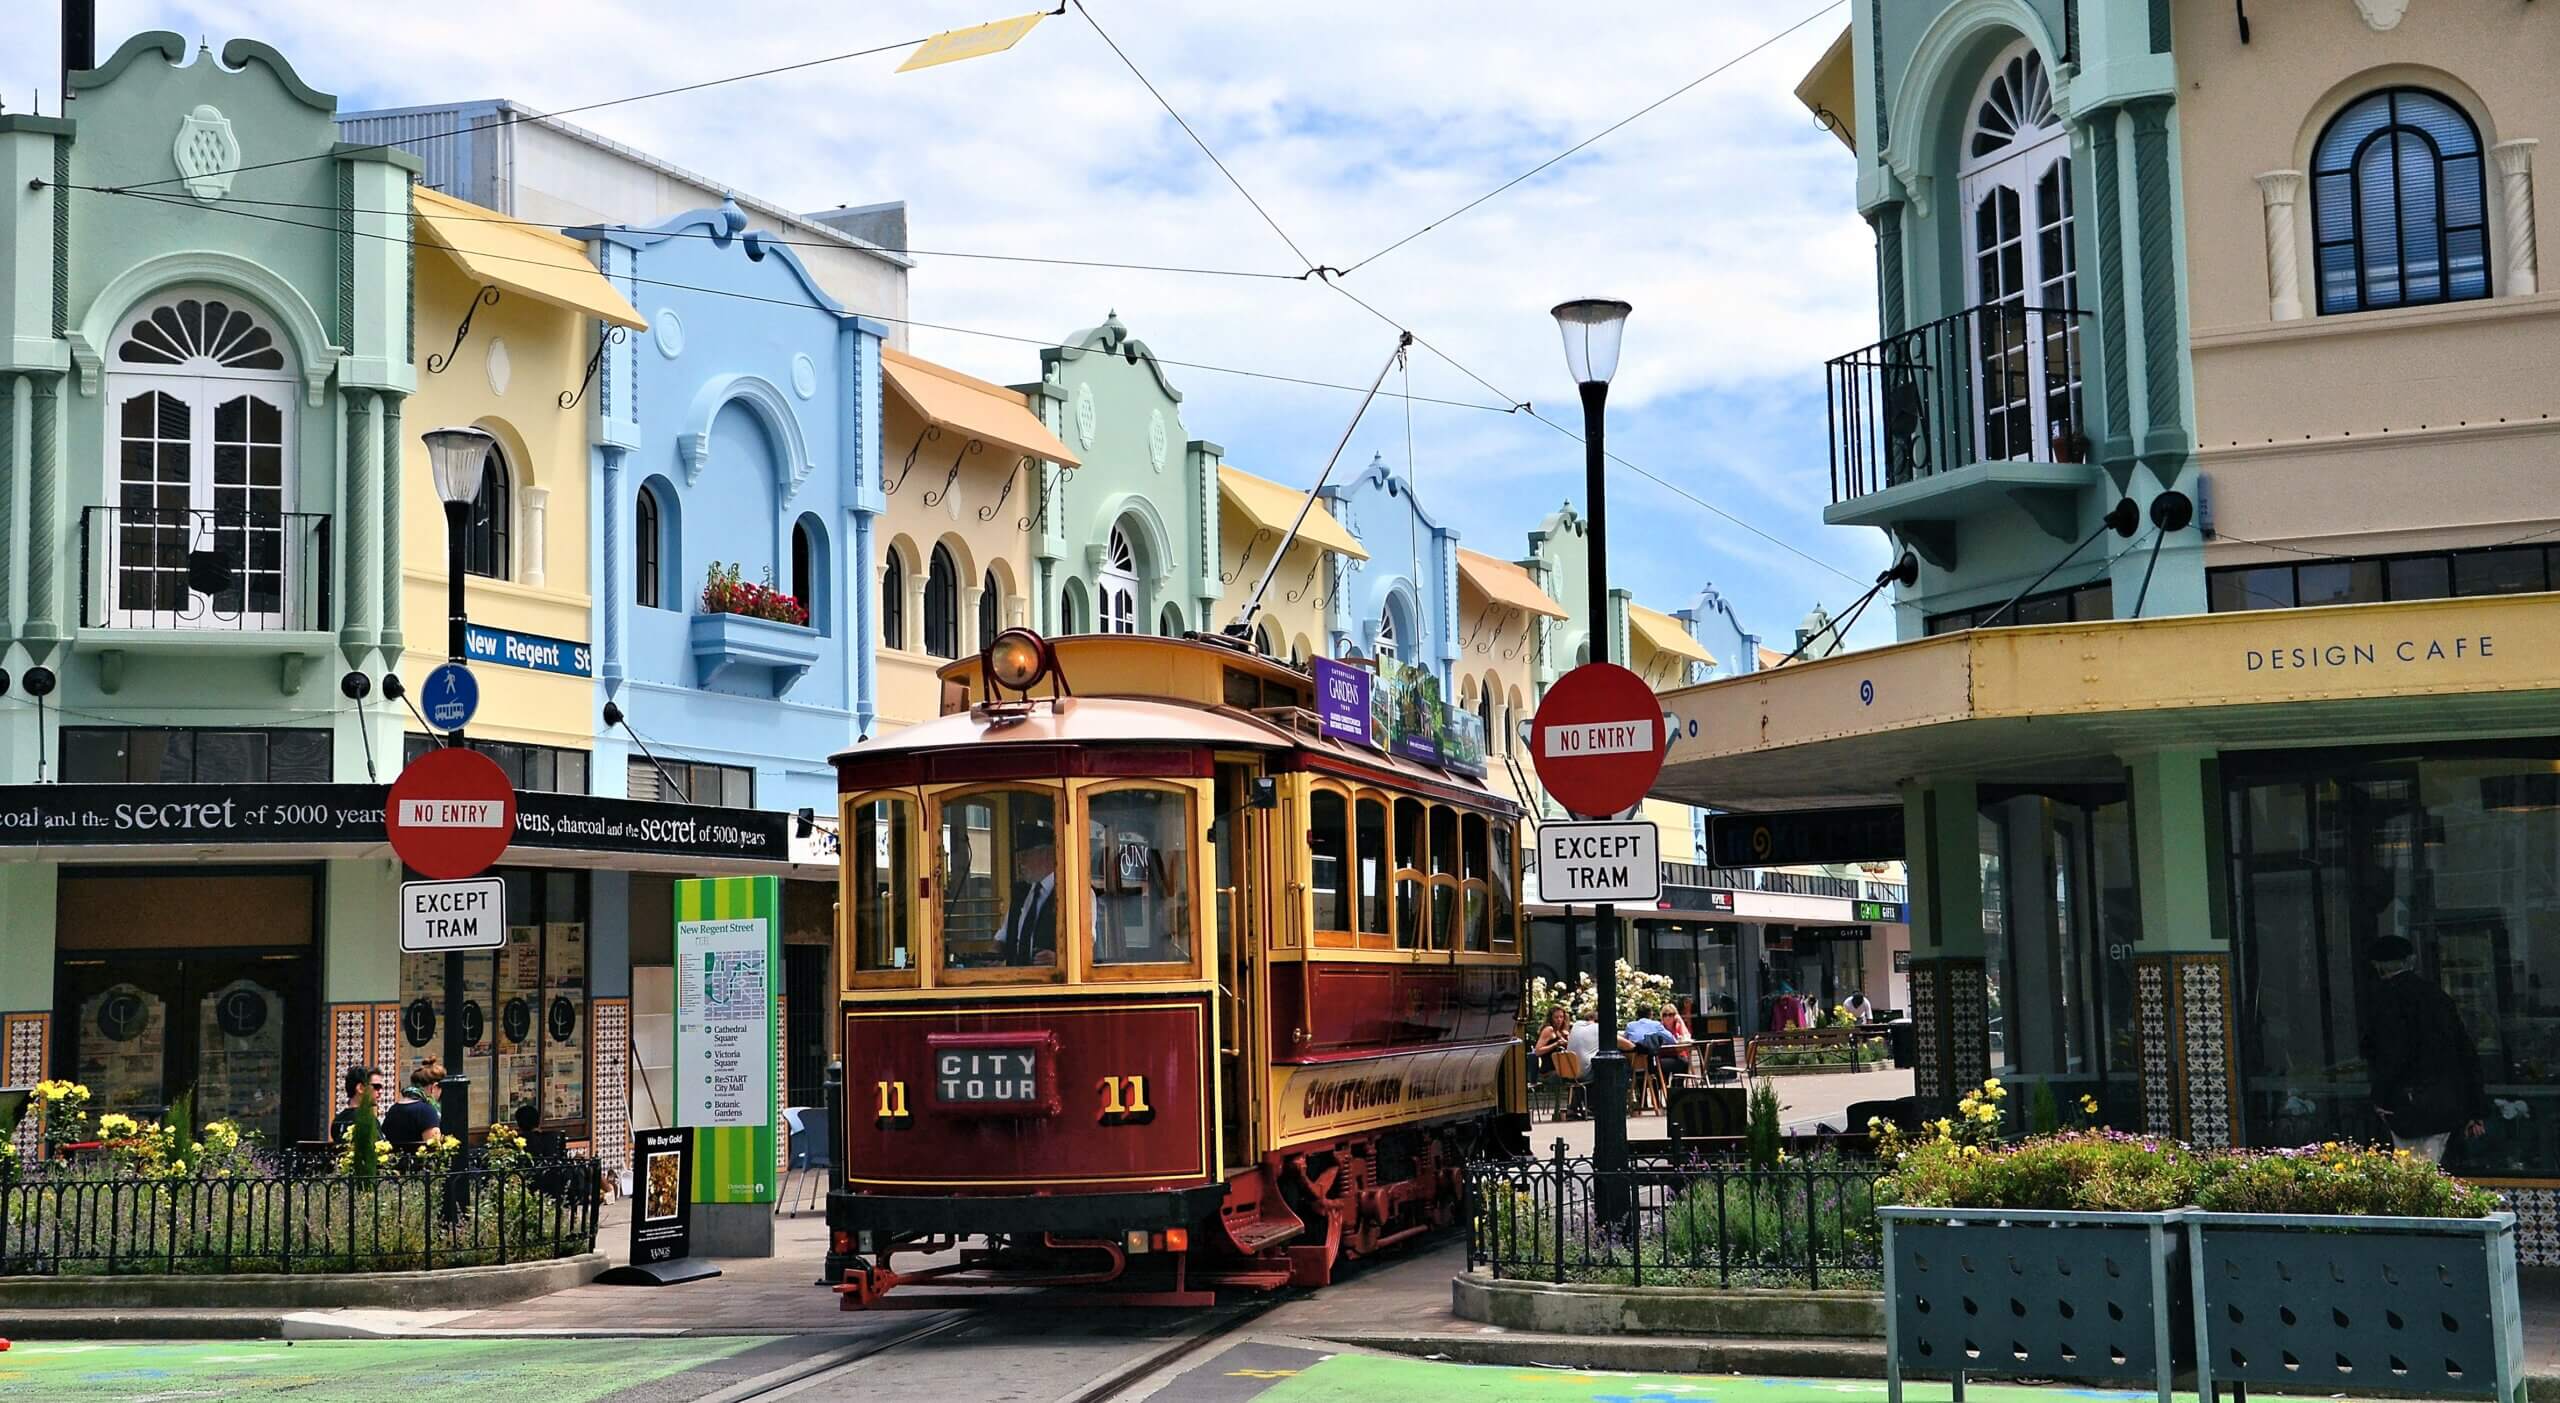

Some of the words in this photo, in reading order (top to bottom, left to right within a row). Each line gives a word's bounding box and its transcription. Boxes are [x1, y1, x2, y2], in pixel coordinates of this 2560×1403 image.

[466, 629, 497, 656] New
[505, 636, 560, 668] Regent
[2247, 643, 2375, 671] DESIGN
[2396, 636, 2494, 662] CAFE
[1329, 677, 1359, 705] GARDENS
[1560, 729, 1580, 751] NO
[1588, 726, 1636, 750] ENTRY
[45, 811, 77, 829] and
[82, 811, 109, 828] the
[115, 796, 237, 831] secret
[244, 804, 270, 826] of
[273, 804, 328, 826] 5000
[335, 805, 387, 830] years
[414, 802, 438, 823] NO
[441, 802, 489, 822] ENTRY
[557, 814, 606, 836] charcoal
[607, 822, 623, 837] and
[625, 822, 639, 839] the
[640, 816, 697, 845] secret
[699, 825, 713, 842] of
[713, 825, 738, 845] 5000
[739, 830, 766, 849] years
[1554, 836, 1641, 859] EXCEPT
[1566, 866, 1629, 889] TRAM
[415, 890, 489, 914] EXCEPT
[425, 916, 478, 938] TRAM
[680, 925, 698, 935] New
[700, 924, 728, 936] Regent
[729, 923, 754, 933] Street
[714, 1024, 748, 1034] Cathedral
[714, 1034, 738, 1043] Square
[714, 1050, 741, 1058] Victoria
[714, 1059, 738, 1068] Square
[942, 1055, 1036, 1076] CITY
[714, 1084, 728, 1092] City
[728, 1083, 744, 1092] Mall
[876, 1081, 909, 1118] 11
[1101, 1075, 1150, 1113] 11
[942, 1079, 1036, 1100] TOUR
[714, 1100, 741, 1108] Botanic
[714, 1109, 743, 1117] Gardens
[647, 1136, 657, 1146] We
[657, 1135, 668, 1147] Buy
[668, 1134, 683, 1144] Gold
